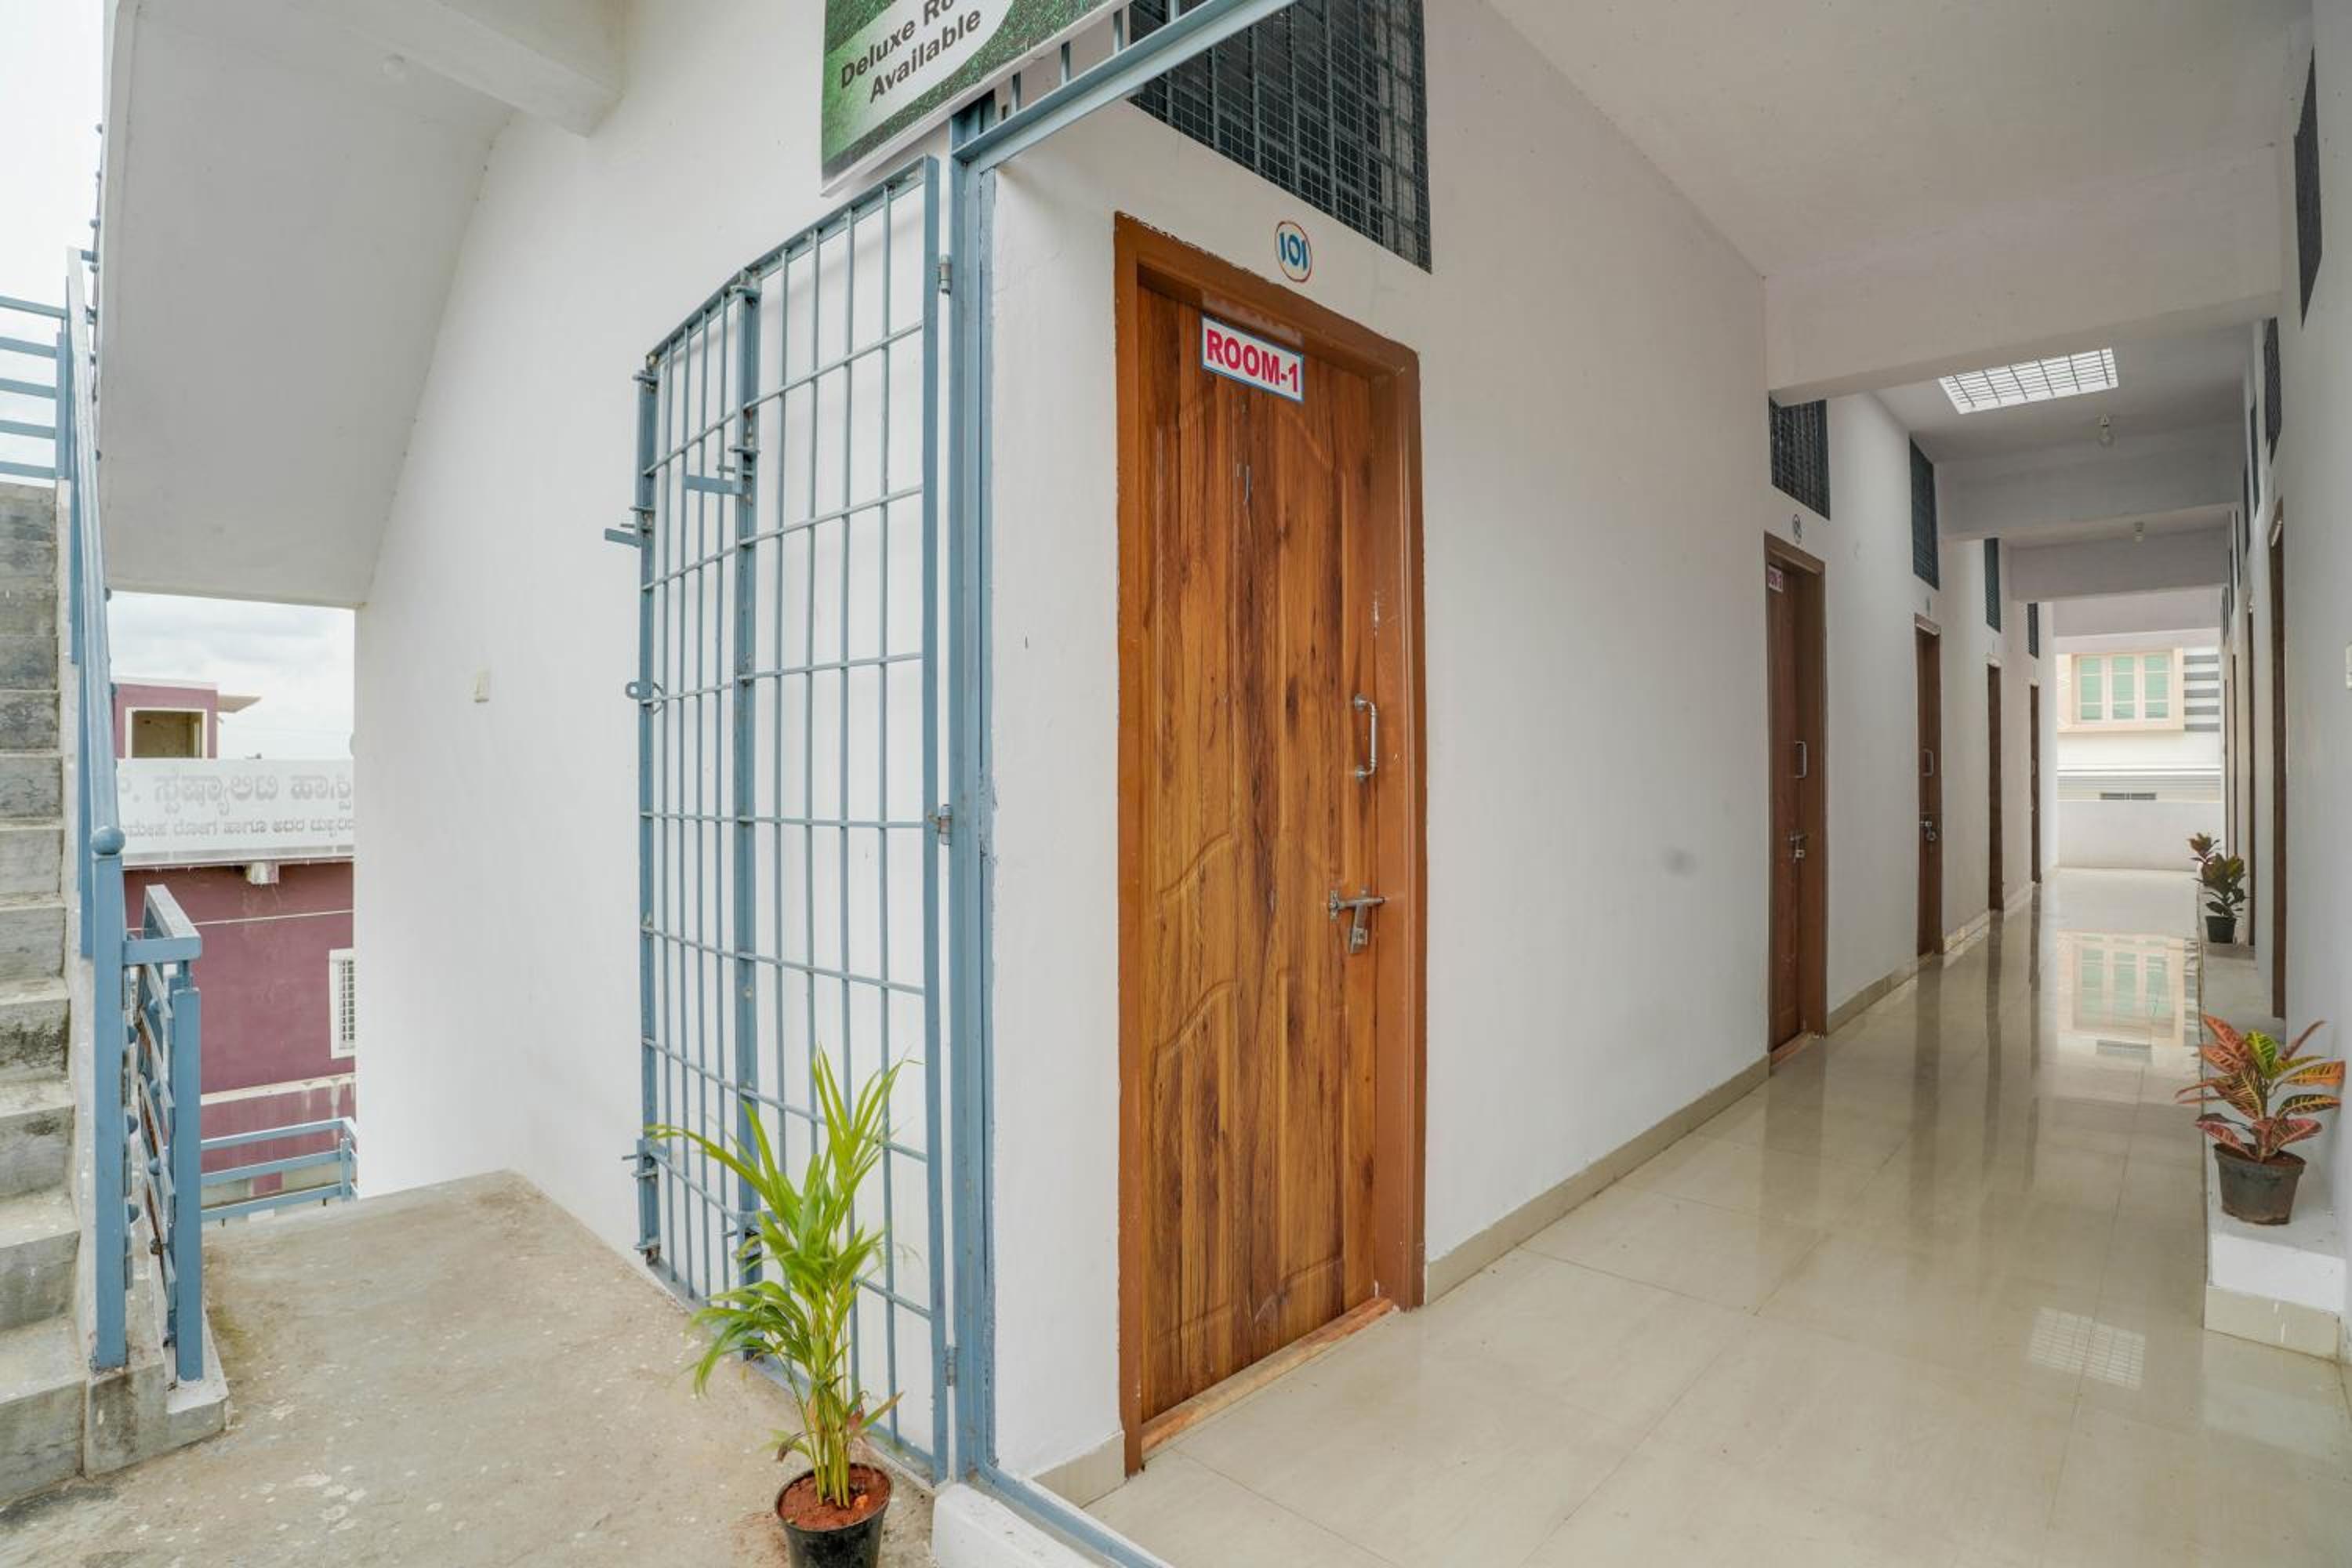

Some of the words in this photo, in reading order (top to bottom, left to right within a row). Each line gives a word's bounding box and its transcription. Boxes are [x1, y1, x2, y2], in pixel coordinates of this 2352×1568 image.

[840, 20, 916, 89] Deluxe
[869, 9, 981, 103] Available
[1279, 231, 1308, 271] 101
[1206, 328, 1299, 393] ROOM-1
